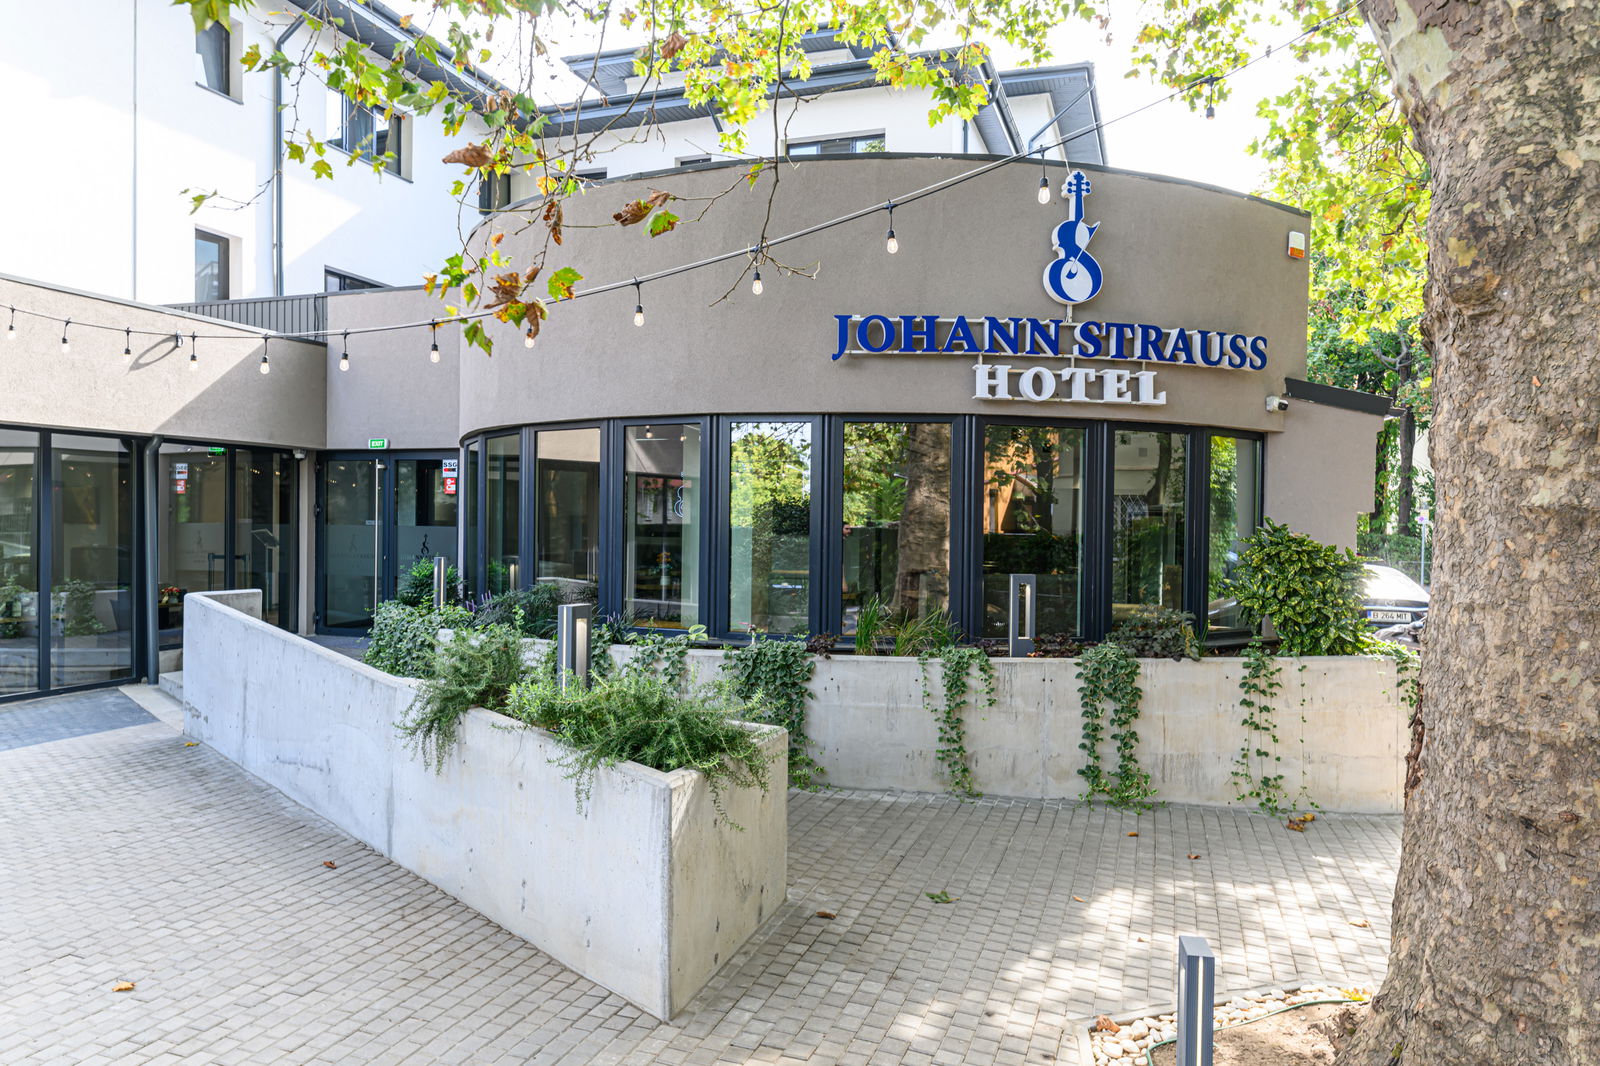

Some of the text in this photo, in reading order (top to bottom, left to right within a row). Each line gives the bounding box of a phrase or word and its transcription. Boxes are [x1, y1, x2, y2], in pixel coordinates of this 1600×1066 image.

[831, 314, 1268, 370] JOHANN STRAUSS
[972, 364, 1167, 405] HOTEL
